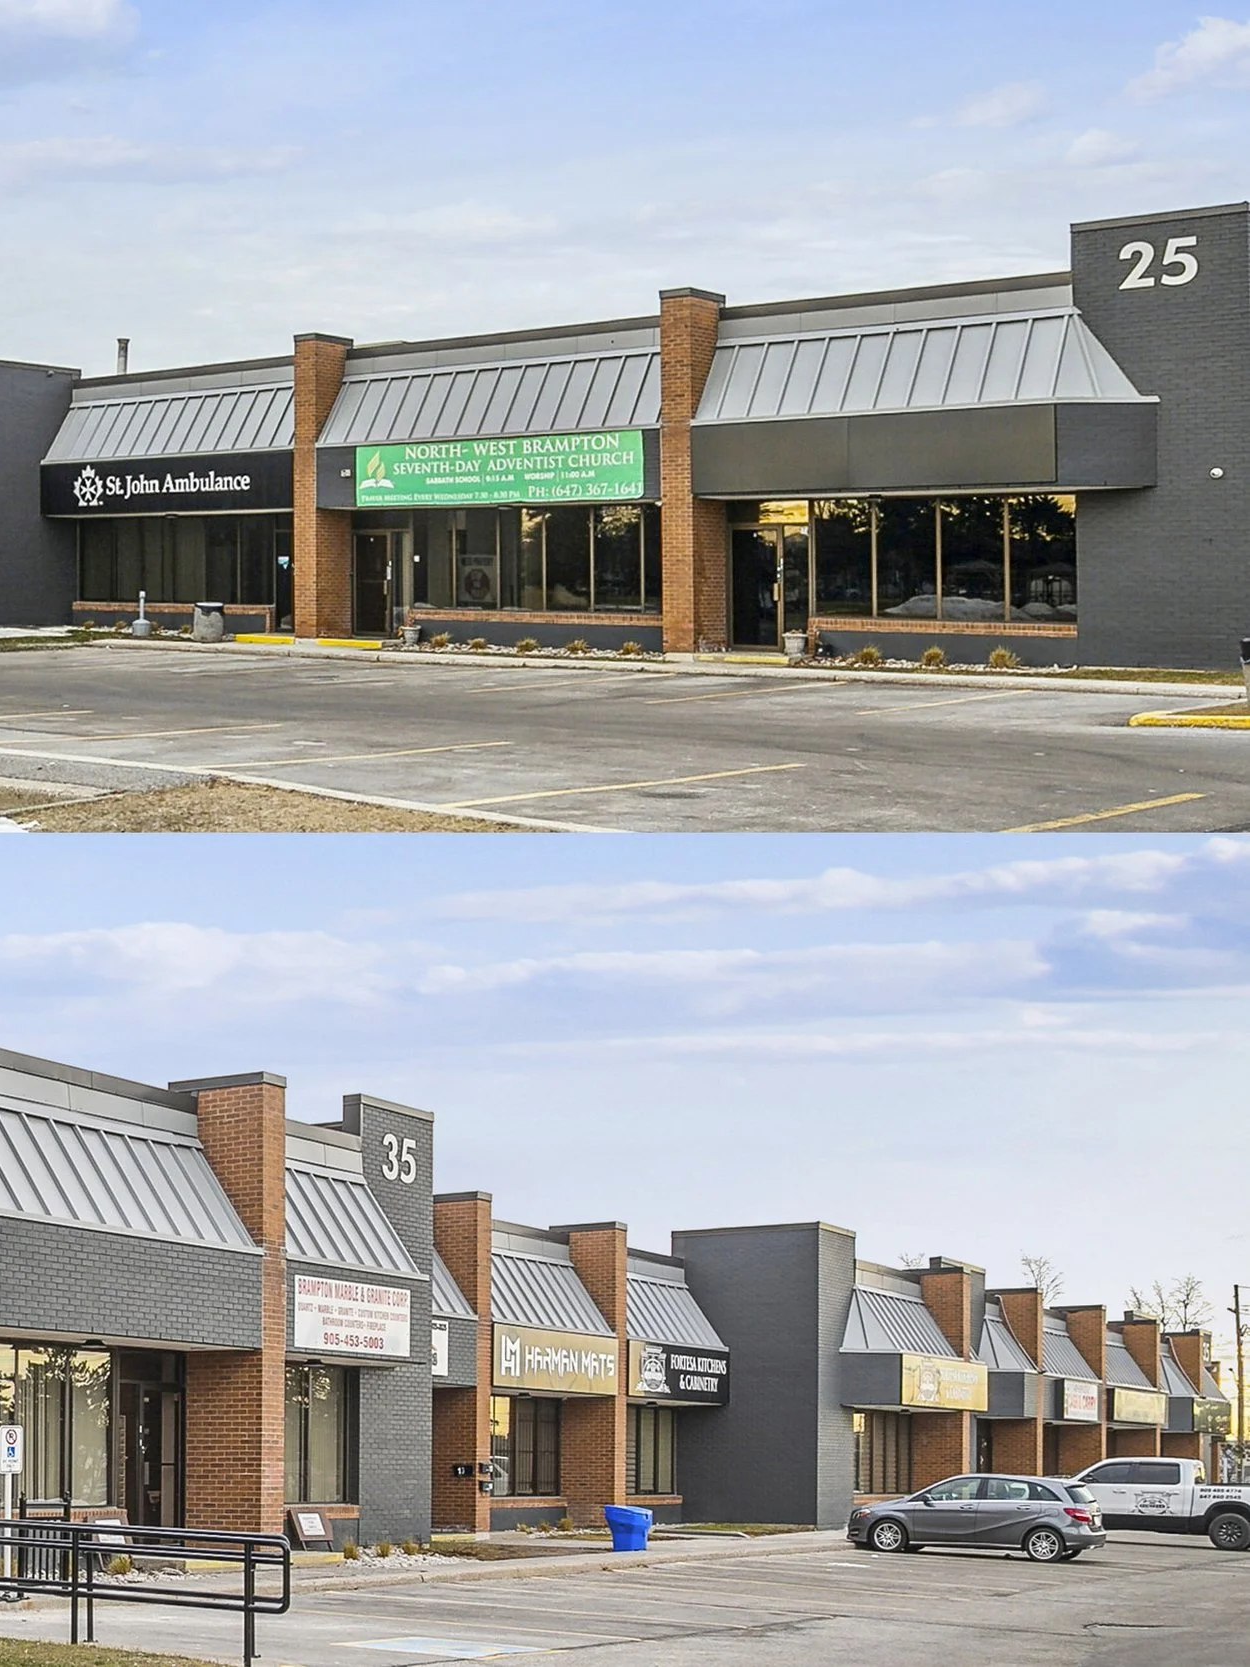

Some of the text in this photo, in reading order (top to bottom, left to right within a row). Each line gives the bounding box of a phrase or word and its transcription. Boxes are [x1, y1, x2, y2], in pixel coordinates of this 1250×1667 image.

[1118, 235, 1198, 290] 25
[473, 441, 517, 456] WEST
[522, 434, 619, 454] BRAMPTON
[393, 451, 634, 475] SEVENTH-DAY ADVENTIST CHURCH
[105, 471, 251, 500] St. John Ambulance
[551, 484, 582, 498] (647)
[382, 1133, 417, 1184] 35
[297, 1278, 333, 1298] BRAMPTON
[335, 1282, 359, 1302] MARBLE
[367, 1287, 391, 1305] GRANITE
[323, 1332, 384, 1349] 905-453-5003
[525, 1345, 615, 1381] HARMAN MATS
[697, 1356, 727, 1375] KITCHENS
[679, 1374, 719, 1392] & CABINETRY
